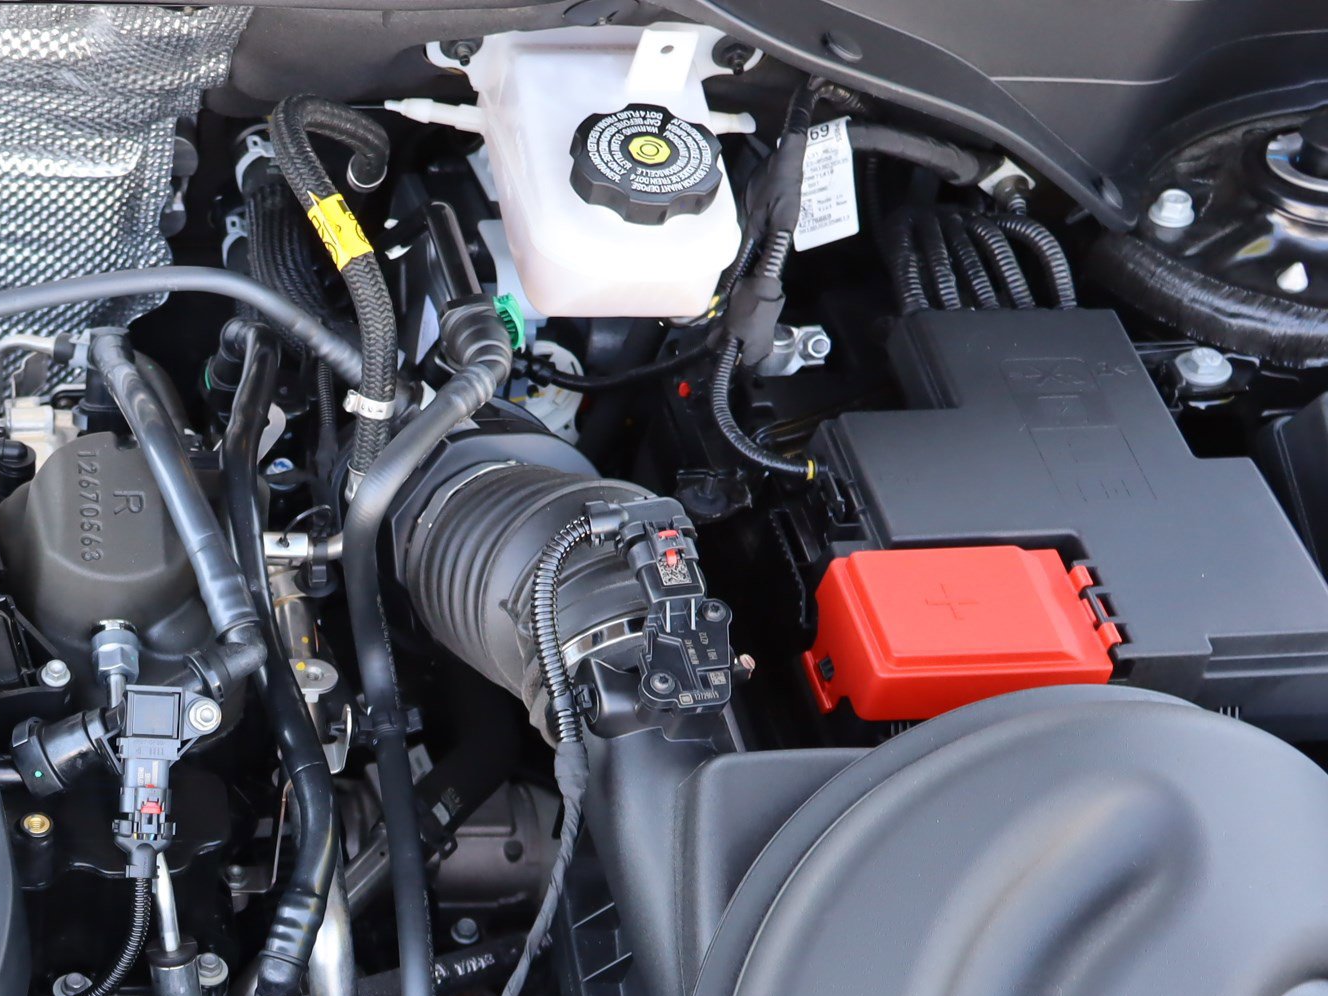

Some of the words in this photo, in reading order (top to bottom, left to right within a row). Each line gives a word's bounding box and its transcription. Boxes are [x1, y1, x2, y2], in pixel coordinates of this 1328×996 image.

[596, 114, 618, 128] FROM
[614, 110, 639, 119] FLUID
[612, 117, 643, 129] BEFORE
[643, 117, 661, 127] CAP
[587, 129, 600, 151] SEALED
[606, 160, 627, 176] ONLY
[650, 177, 672, 185] FREIN
[659, 182, 685, 193] AVANT
[77, 450, 104, 562] 12670563
[113, 490, 146, 515] R
